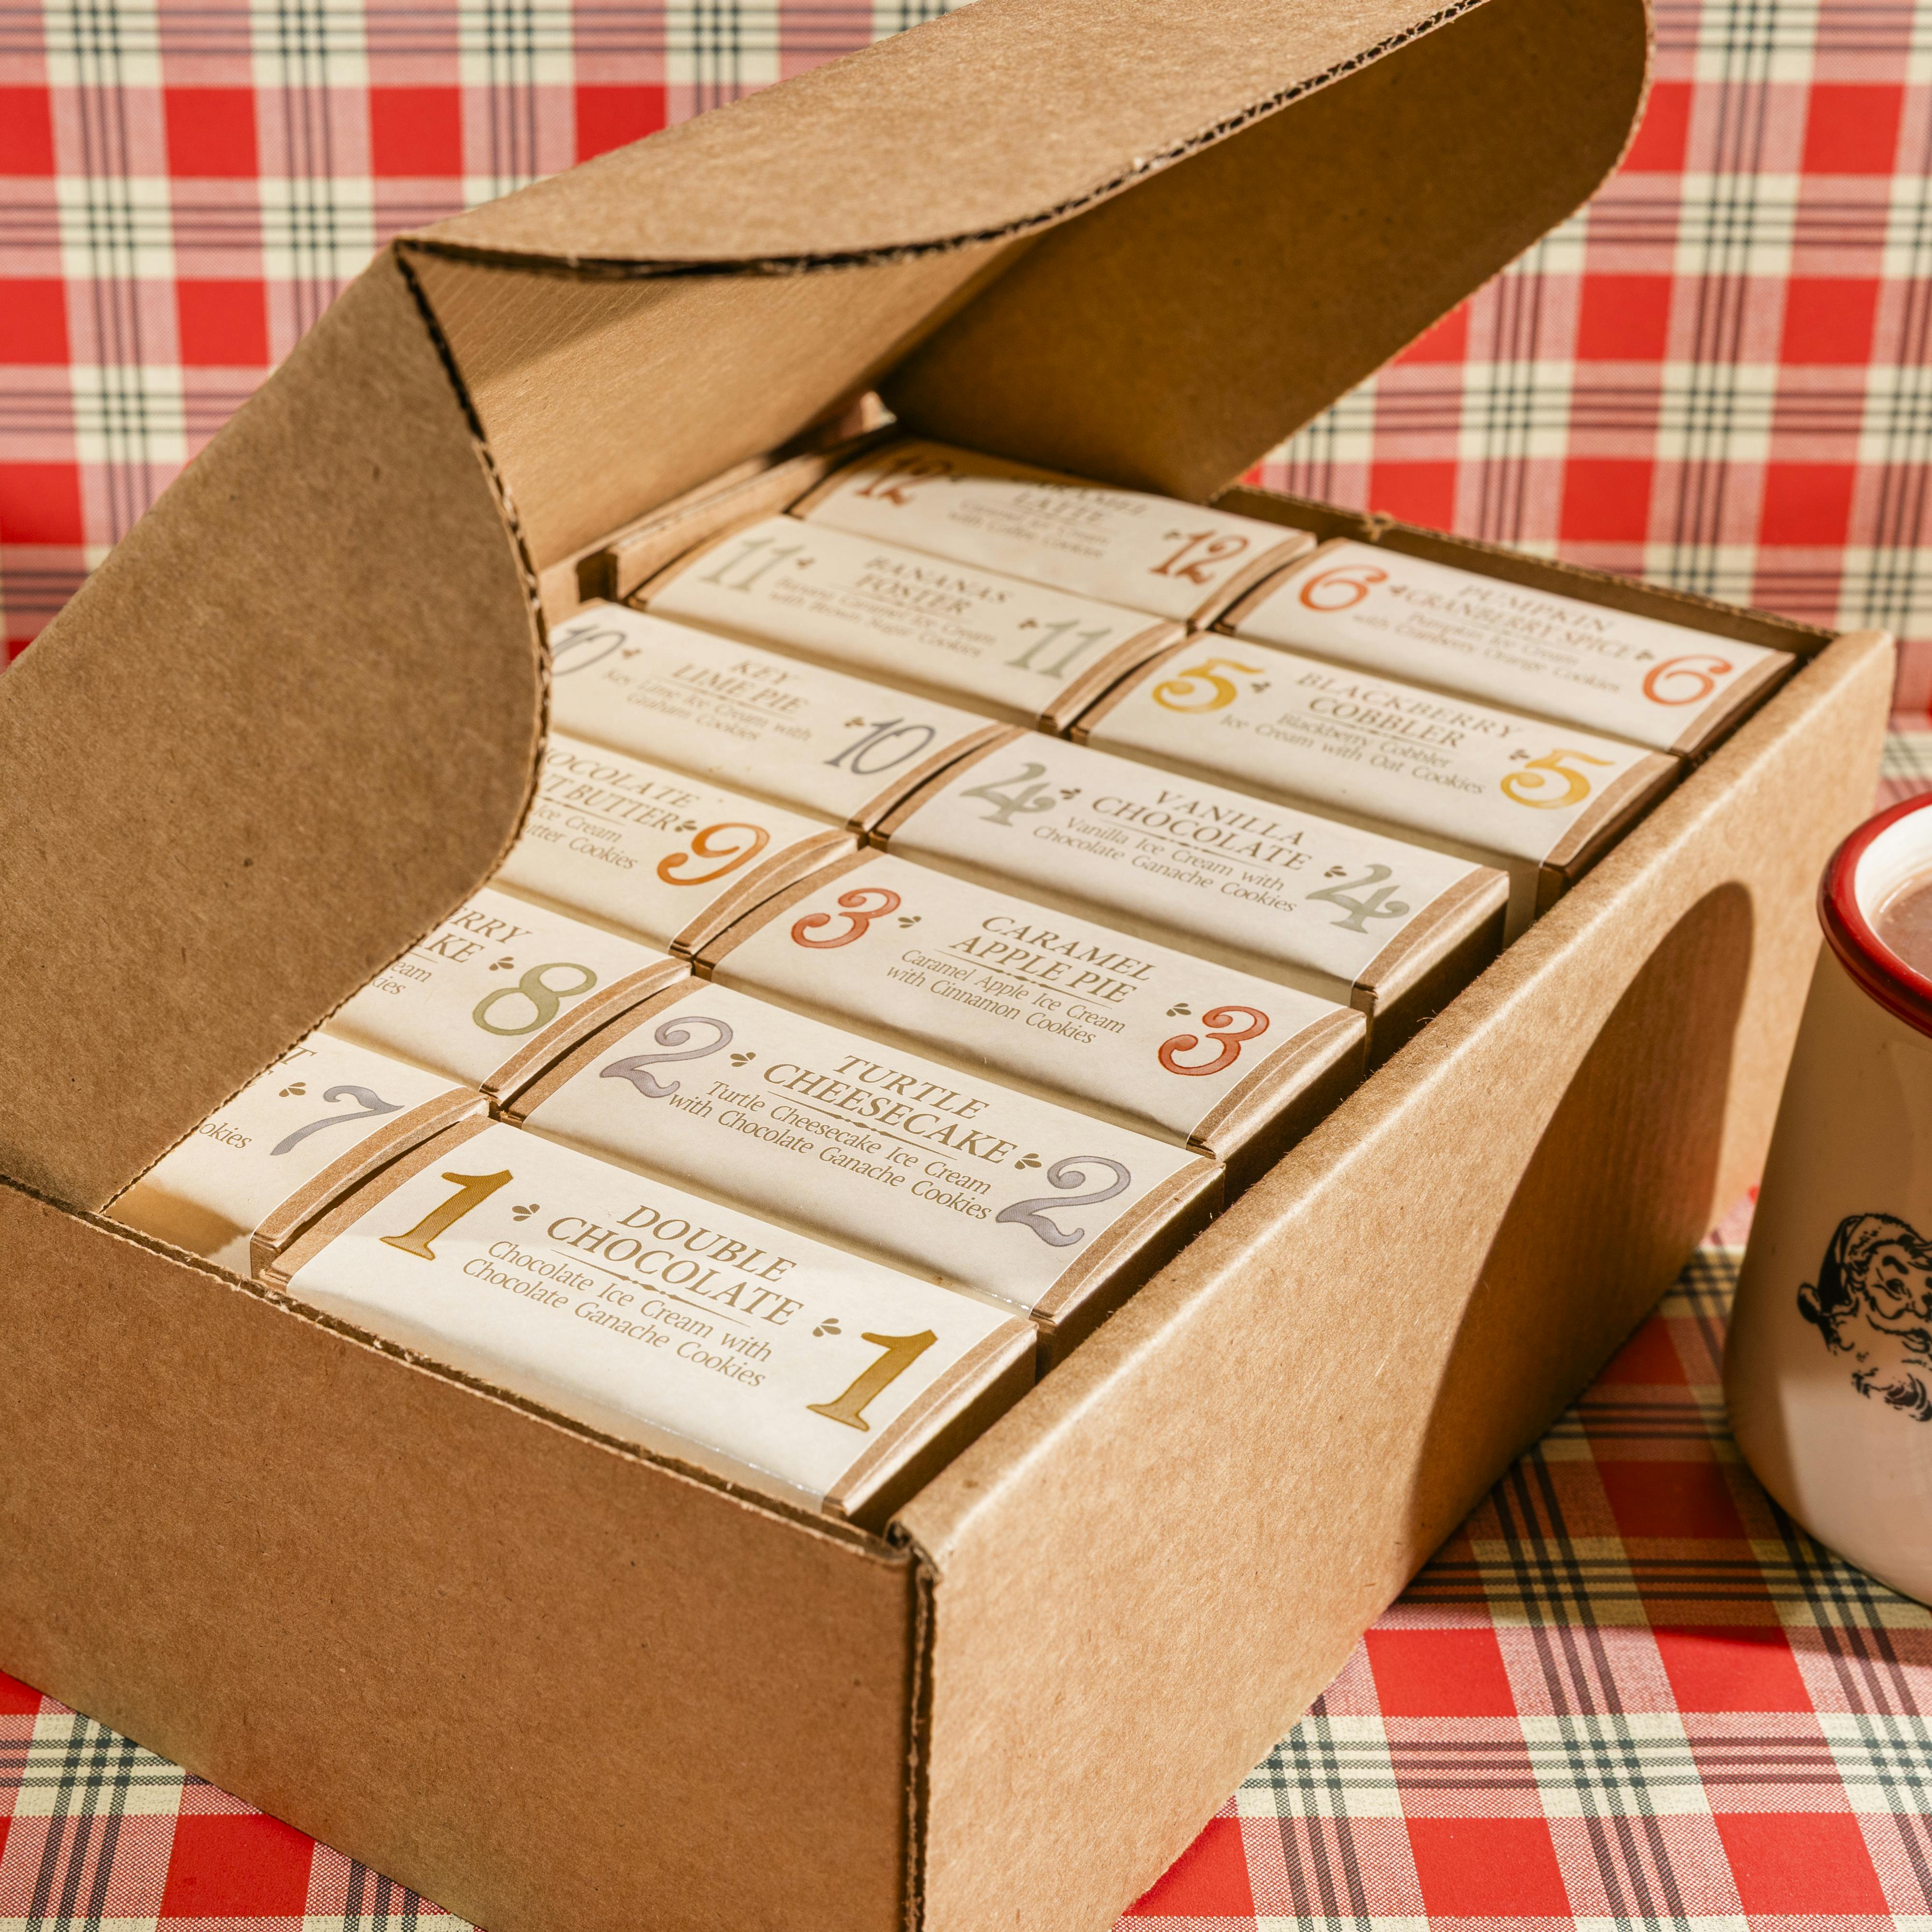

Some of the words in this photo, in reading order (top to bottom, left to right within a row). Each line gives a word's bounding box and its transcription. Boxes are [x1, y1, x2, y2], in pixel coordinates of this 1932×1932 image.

[697, 536, 807, 594] 11
[862, 555, 1013, 604] BANANAS
[1148, 530, 1249, 584] 12
[1299, 564, 1389, 612] 6
[854, 573, 972, 614] FOSTER
[1404, 589, 1553, 639] CRANBERRY
[1458, 585, 1616, 633] PUMPKIN
[730, 659, 800, 685] KEY
[1004, 619, 1112, 679] 11
[1643, 653, 1733, 707] 6
[672, 663, 755, 696] LIME
[749, 687, 810, 712] PIE
[1152, 658, 1265, 713] 5
[1295, 672, 1522, 738] BLACKBERRY
[696, 713, 762, 742] Cookies
[713, 702, 770, 728] Cream
[772, 722, 813, 742] with
[824, 716, 936, 776] 10
[1277, 712, 1371, 750] Blackberry
[1379, 740, 1453, 768] Cobbler
[1309, 696, 1466, 749] COBBLER
[546, 749, 700, 810] OCOLATE
[1221, 714, 1250, 728] Ice
[1255, 724, 1315, 749] Cream
[1321, 741, 1363, 762] with
[1370, 753, 1406, 773] Oat
[1411, 766, 1485, 796] Cookies
[1500, 748, 1616, 810] 5
[543, 773, 574, 792] T
[567, 784, 679, 831] BUTTER
[959, 762, 1056, 827] 4
[1156, 790, 1305, 847] VANILLA
[566, 815, 622, 843] Cream
[568, 837, 638, 870] Cookies
[657, 822, 770, 886] 9
[1066, 817, 1129, 844] Vanilla
[1134, 838, 1165, 855] Ice
[1172, 850, 1234, 876] Cream
[1241, 870, 1285, 892] with
[1092, 796, 1313, 871] CHOCOLATE
[1033, 825, 1125, 860] Chocolate
[1132, 854, 1214, 888] Ganache
[1221, 882, 1297, 912] Cookies
[1305, 864, 1409, 934] 4
[416, 933, 484, 963] KE
[449, 906, 532, 944] RRY
[791, 887, 901, 949] 3
[982, 916, 1157, 981] CARAMEL
[472, 962, 597, 1036] 8
[901, 949, 976, 981] Caramel
[974, 975, 1029, 1000] Apple
[1032, 993, 1062, 1011] Ice
[1066, 1004, 1126, 1034] Cream
[949, 936, 1072, 981] APPLE
[1066, 970, 1138, 1003] PIE
[886, 966, 927, 987] with
[930, 979, 1020, 1020] Cinnamon
[1025, 1010, 1096, 1044] Cookies
[599, 1016, 733, 1098] 2
[1158, 1006, 1269, 1076] 3
[764, 1064, 1019, 1165] CHEESECAKE
[833, 1055, 990, 1120] TURTLE
[199, 1122, 253, 1149] okies
[270, 1085, 405, 1155] 7
[705, 1080, 765, 1112] Turtle
[770, 1106, 882, 1154] Cheesecake
[884, 1146, 919, 1167] Ice
[923, 1160, 991, 1195] Cream
[669, 1094, 713, 1118] with
[718, 1109, 814, 1154] Chocolate
[819, 1146, 906, 1187] Ganache
[911, 1180, 992, 1220] Cookies
[379, 1169, 513, 1261] 1
[995, 1155, 1131, 1247] 2
[546, 1217, 805, 1326] CHOCOLATE
[616, 1205, 797, 1282] DOUBLE
[463, 1258, 569, 1308] Chocolate
[575, 1302, 671, 1348] Ganache
[676, 1340, 766, 1387] Cookies
[488, 1241, 595, 1291] Chocolate
[597, 1282, 635, 1307] Ice
[640, 1299, 714, 1339] Cream
[724, 1332, 772, 1362] with
[807, 1329, 938, 1432] 1
